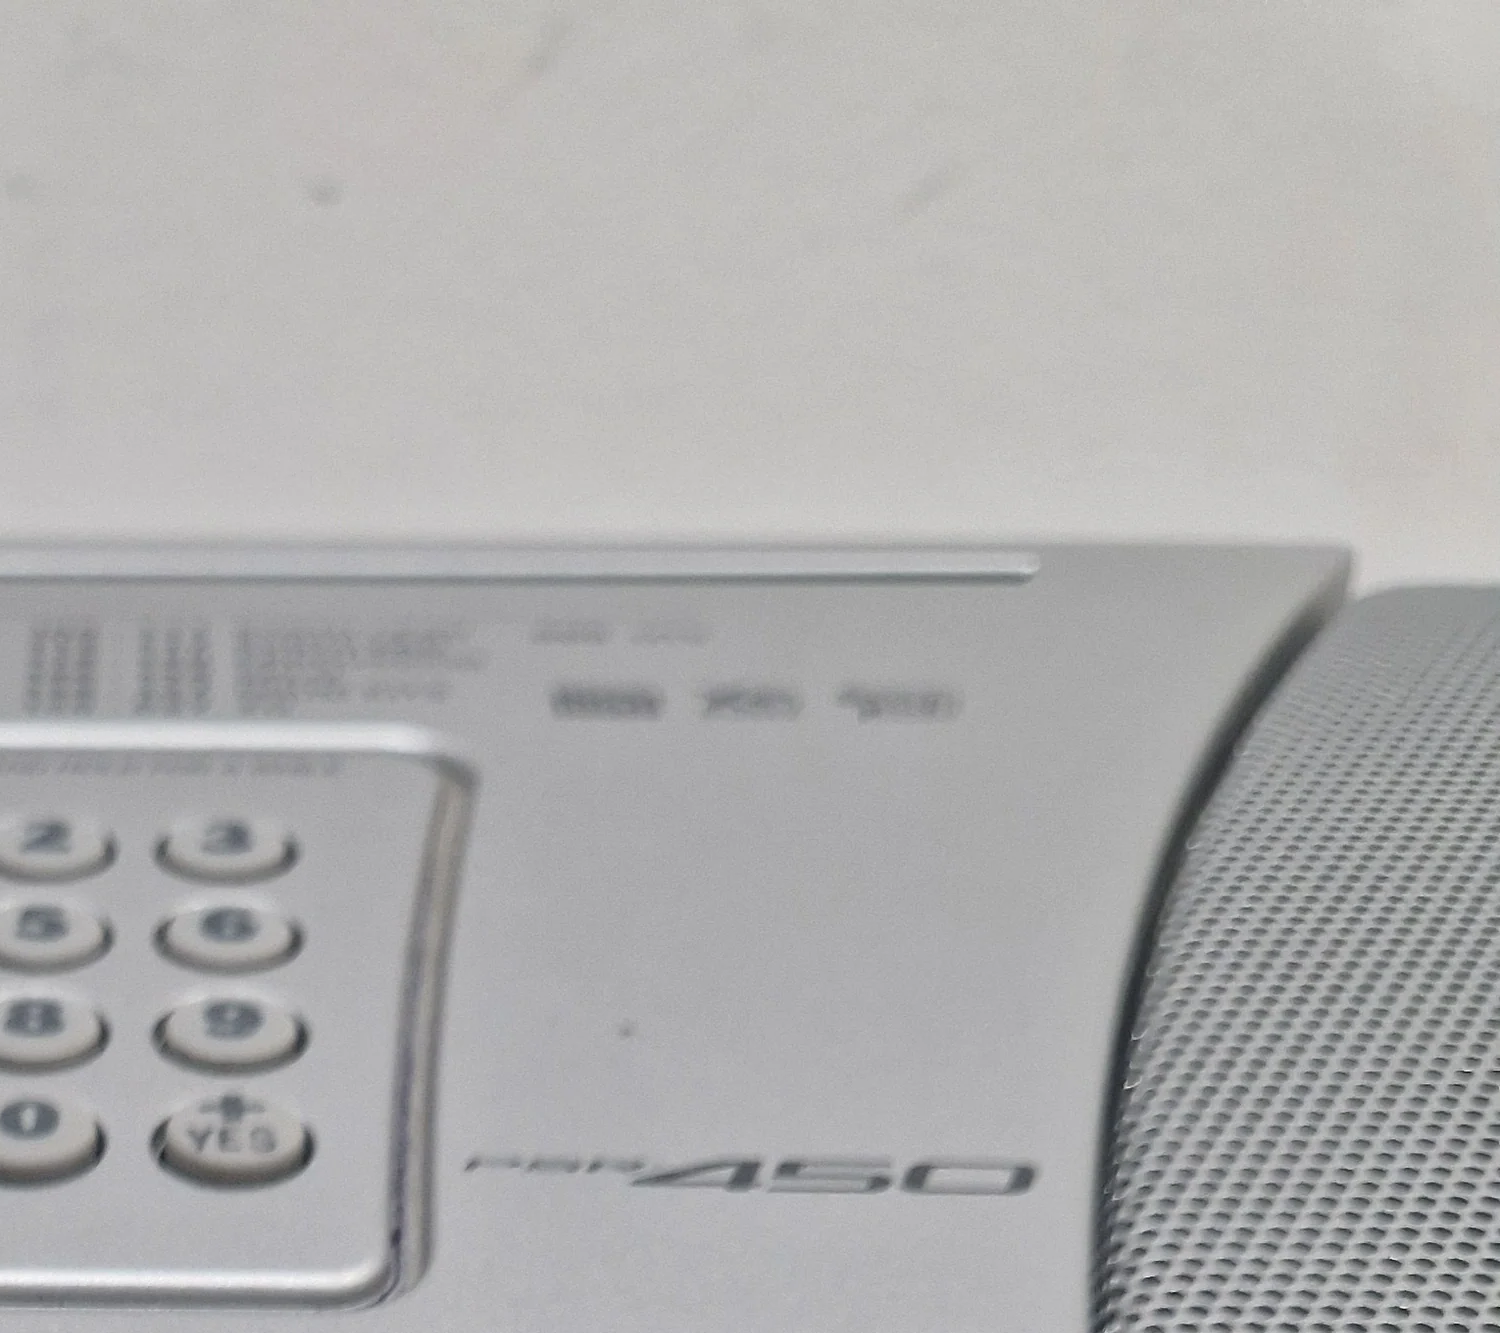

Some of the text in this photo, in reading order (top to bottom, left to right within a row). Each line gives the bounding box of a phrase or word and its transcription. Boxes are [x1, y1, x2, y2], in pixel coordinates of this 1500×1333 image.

[19, 818, 73, 855] 2
[202, 818, 255, 856] 3
[15, 903, 69, 941] 5
[199, 905, 259, 943] 6
[3, 998, 65, 1039] 8
[203, 999, 266, 1041] 9
[187, 1127, 277, 1154] YES
[630, 1160, 1037, 1196] 450
